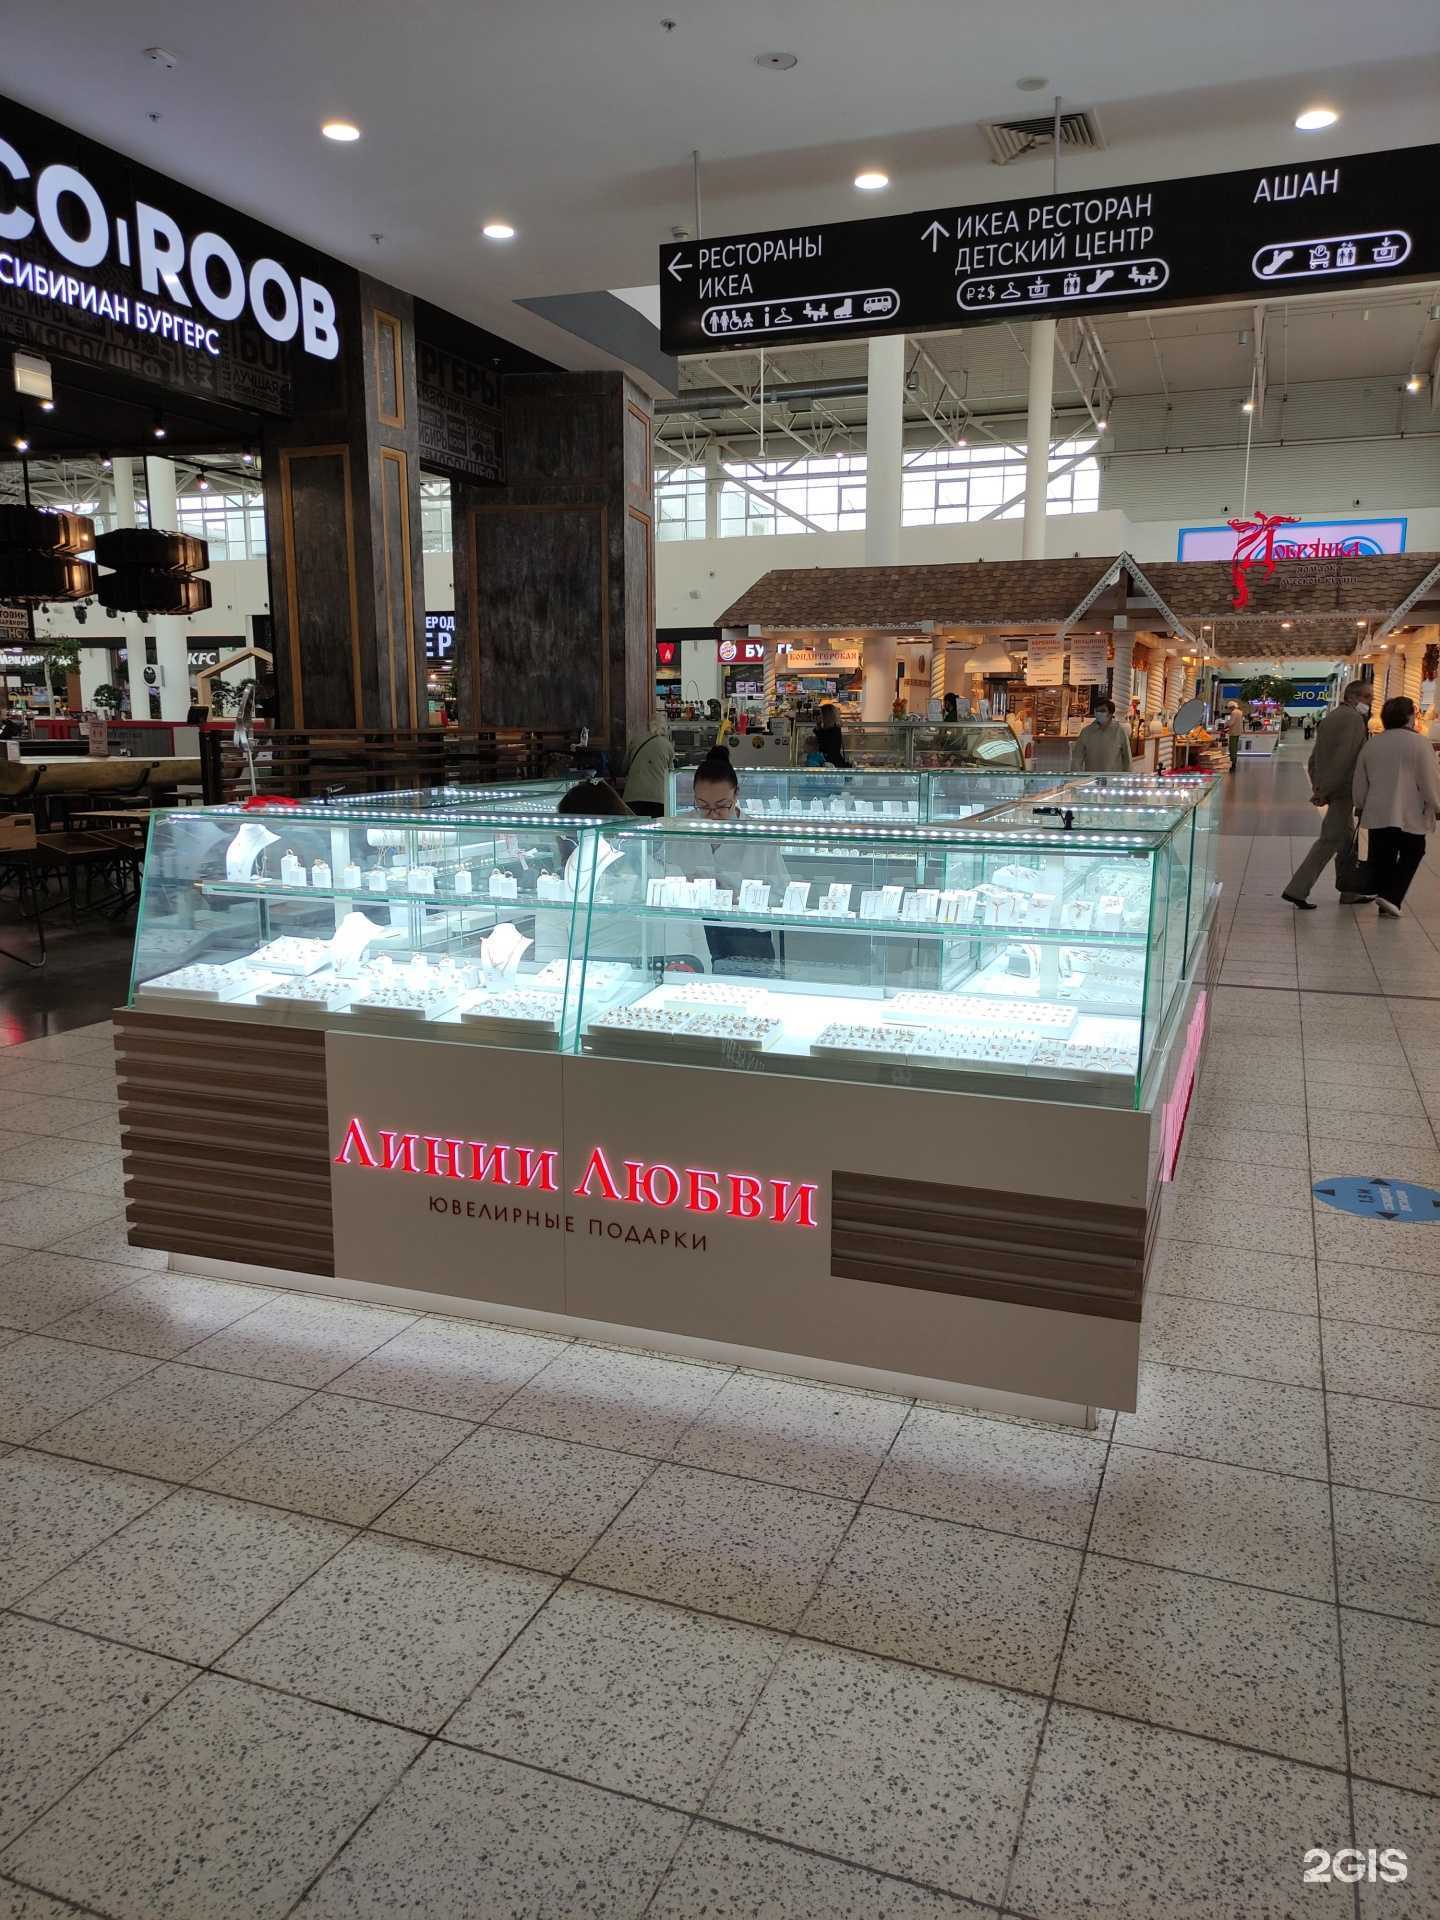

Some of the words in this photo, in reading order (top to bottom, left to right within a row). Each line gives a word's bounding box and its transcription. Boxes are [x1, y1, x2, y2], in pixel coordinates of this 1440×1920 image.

[1253, 169, 1339, 203] АШАН
[957, 211, 1019, 239] ИКЕА
[1028, 193, 1152, 230] РЕСТОРАН
[699, 234, 822, 269] РЕСТОРАНЫ
[955, 233, 1065, 275] ДЕТСКИЙ
[1075, 226, 1153, 260] ЦЕНТР
[0, 254, 129, 325] СИБИРИАН
[136, 301, 220, 355] БУРГЕРС
[699, 273, 753, 299] ИКЕА
[187, 652, 217, 665] KFC
[335, 1118, 559, 1191] ЛИНИИ
[574, 1147, 818, 1226] ЛЮБВИ
[429, 1195, 575, 1233] ЮВЕЛИРНЫЕ
[589, 1219, 707, 1251] ПОДАРКИ
